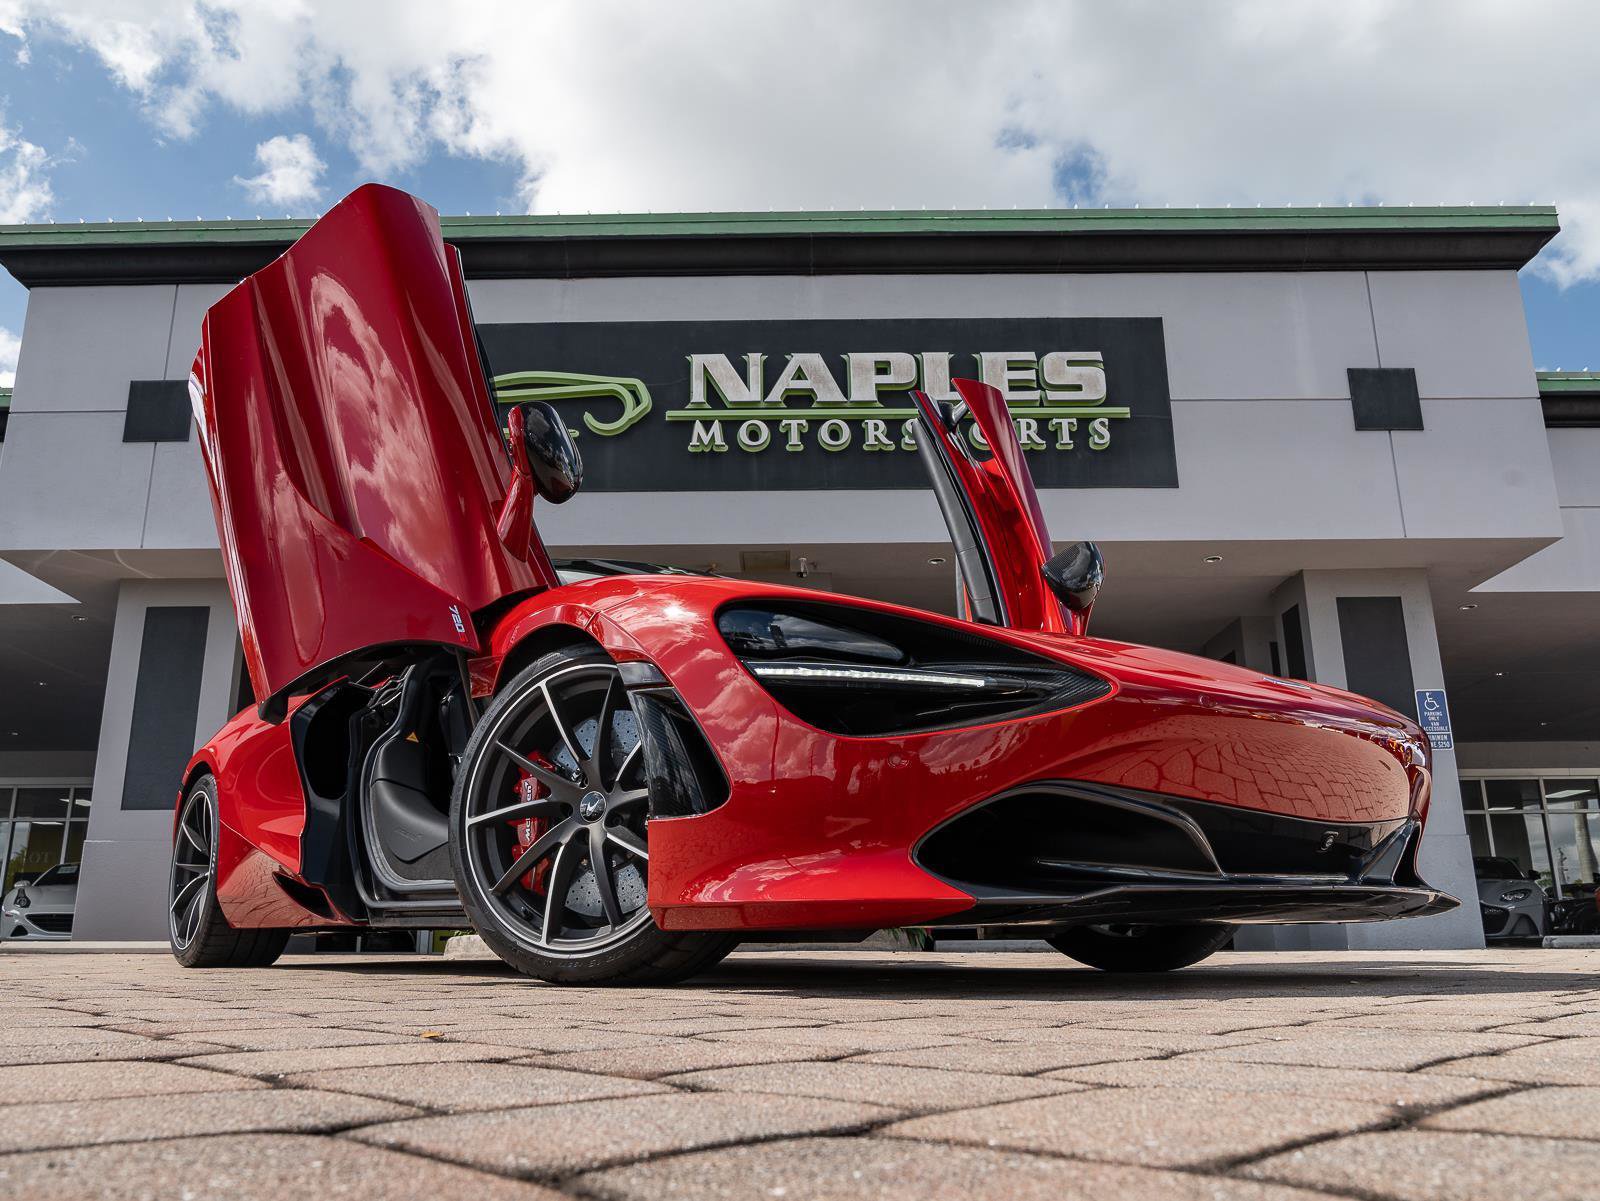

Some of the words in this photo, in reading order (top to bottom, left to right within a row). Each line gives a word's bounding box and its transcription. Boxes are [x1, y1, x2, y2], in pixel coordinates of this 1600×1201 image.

[685, 351, 1107, 408] NAPLES
[688, 418, 1110, 451] MOTORSRTS
[524, 781, 532, 841] Mcen
